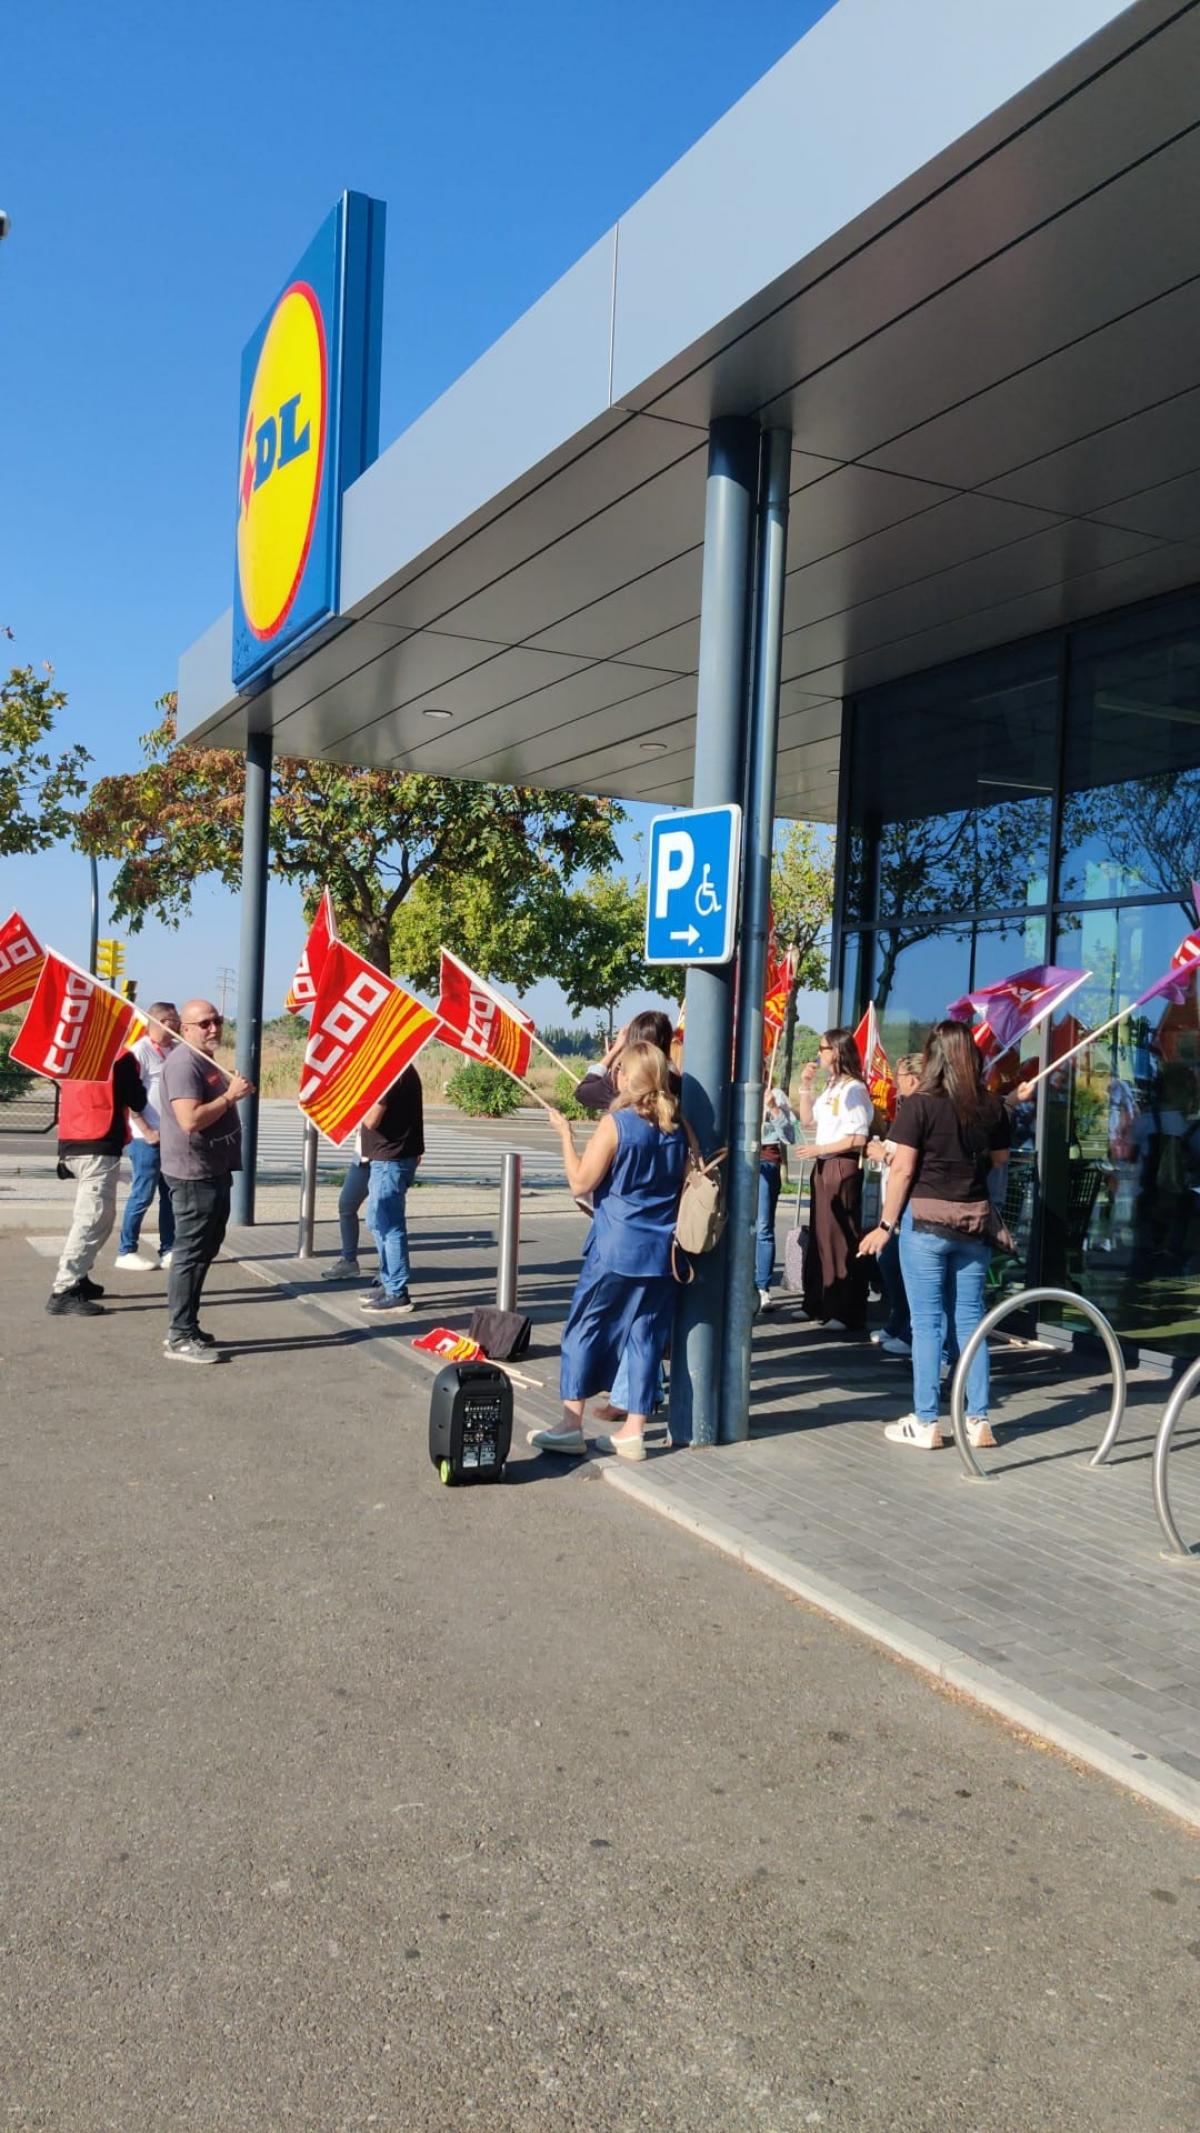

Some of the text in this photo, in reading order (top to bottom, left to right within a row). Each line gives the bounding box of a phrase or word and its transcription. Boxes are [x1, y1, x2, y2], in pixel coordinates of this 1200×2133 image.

[655, 831, 695, 918] P
[43, 971, 95, 1074] CCOO
[461, 980, 497, 1057] CCO
